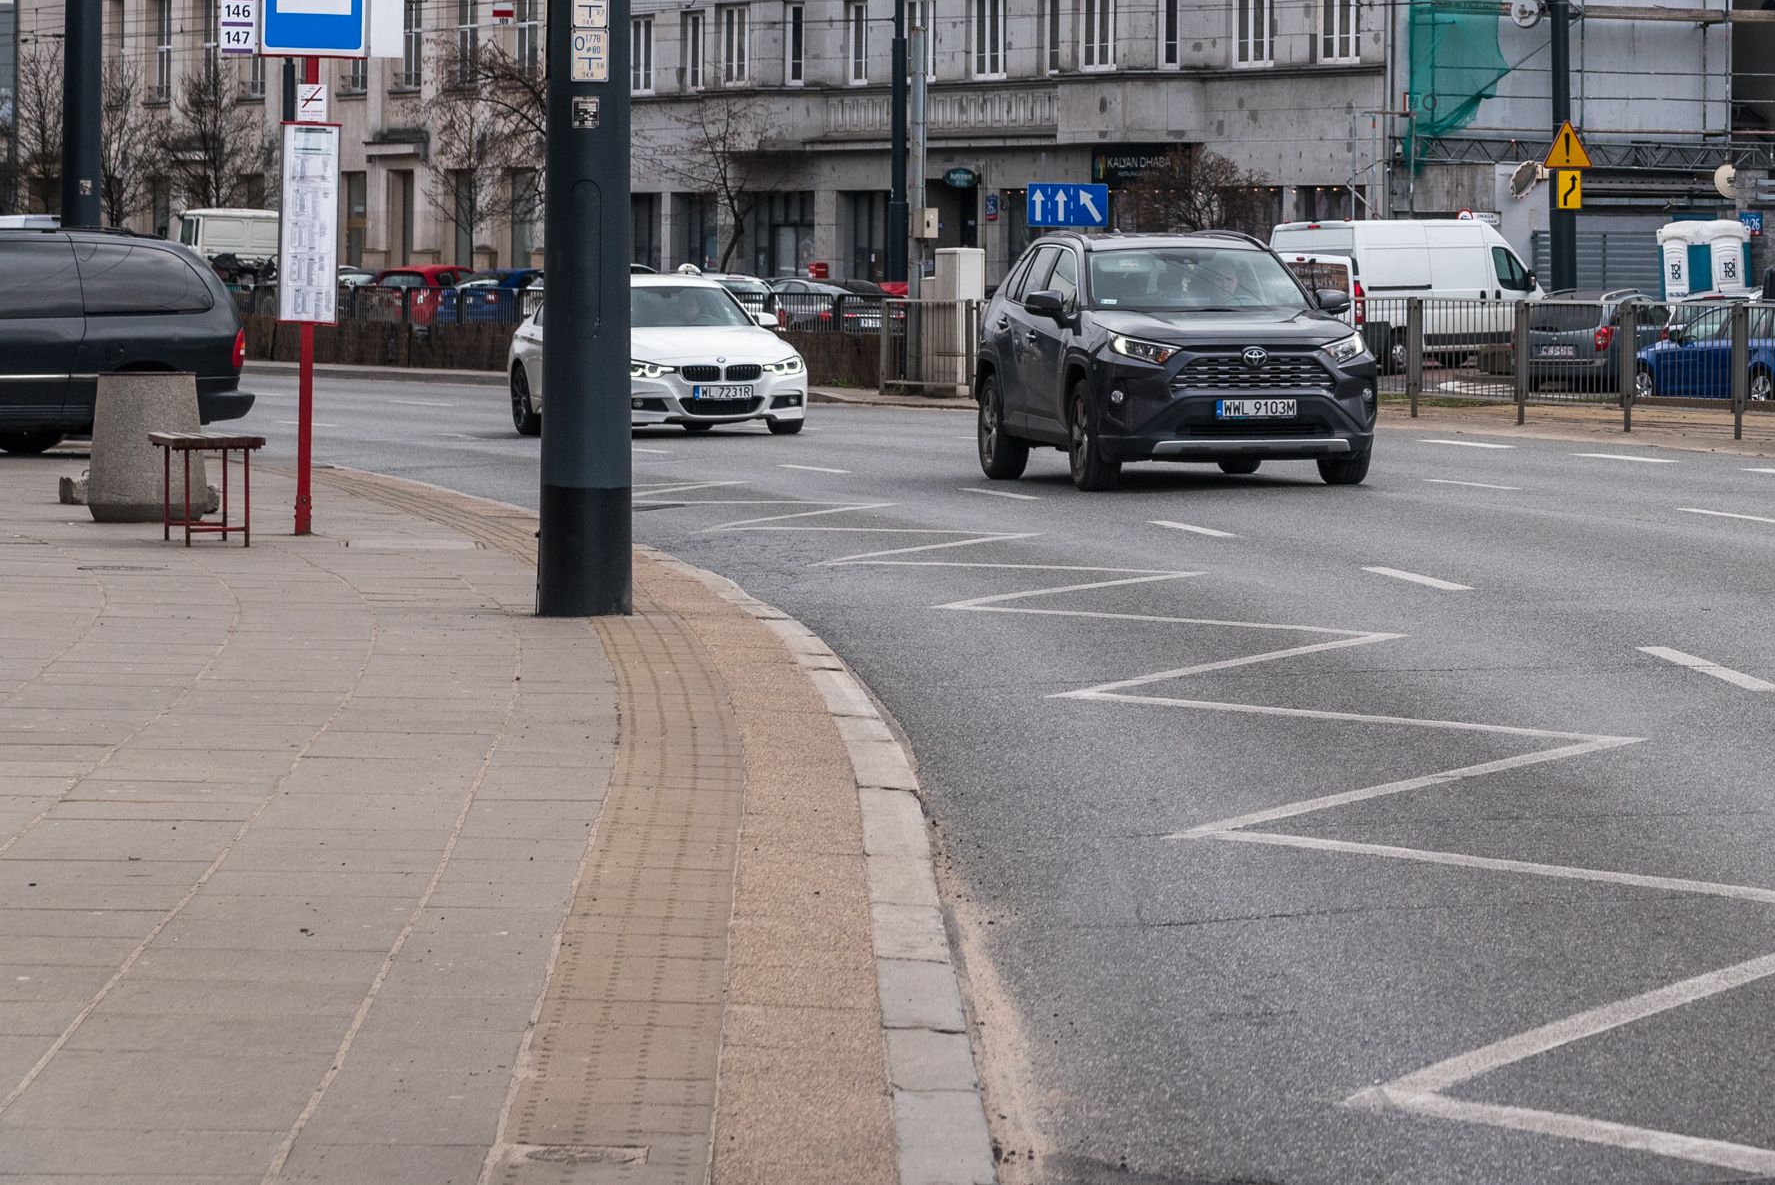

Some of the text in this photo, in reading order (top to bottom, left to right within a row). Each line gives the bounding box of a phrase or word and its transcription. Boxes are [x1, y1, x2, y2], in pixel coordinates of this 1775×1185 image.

[225, 4, 250, 18] 146
[225, 31, 250, 44] 147
[1107, 156, 1171, 168] KALYAN DHABA
[702, 387, 750, 397] WL 7231R
[1224, 401, 1295, 415] WWL 9103M
